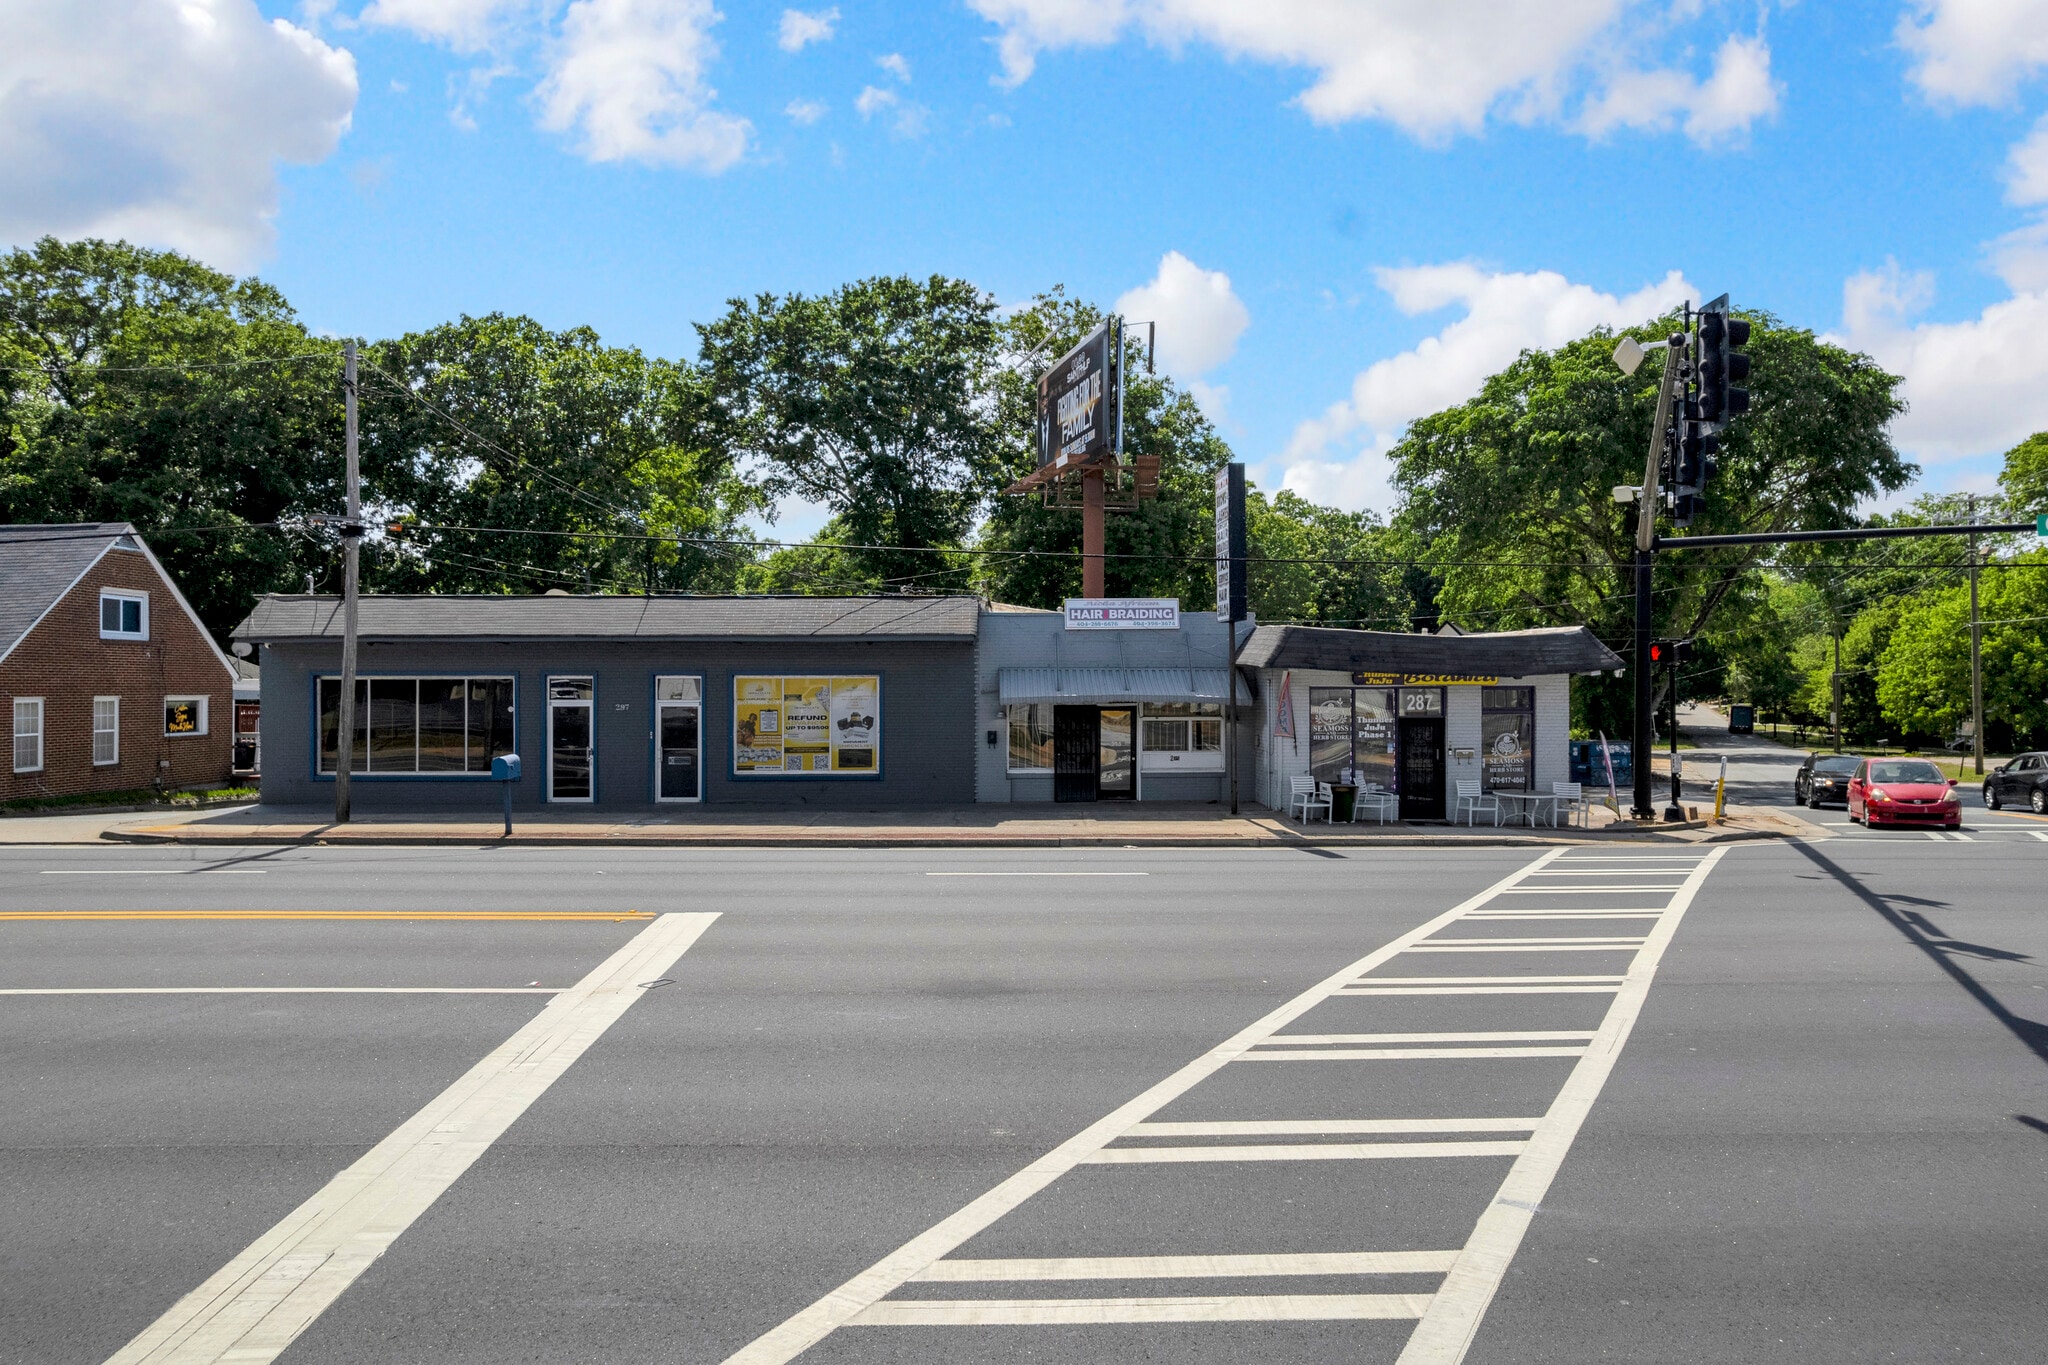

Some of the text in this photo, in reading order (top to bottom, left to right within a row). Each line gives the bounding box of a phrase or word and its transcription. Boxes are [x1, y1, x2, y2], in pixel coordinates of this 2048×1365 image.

[1057, 368, 1102, 425] FIGHTING FOR THE
[1061, 402, 1095, 444] FAMILY
[1217, 554, 1229, 572] TAX
[1070, 608, 1173, 620] HAIR BRAIDING
[615, 703, 630, 711] 297
[1406, 694, 1433, 711] 287
[1358, 730, 1392, 738] Phase 1
[1364, 723, 1386, 731] JuJu
